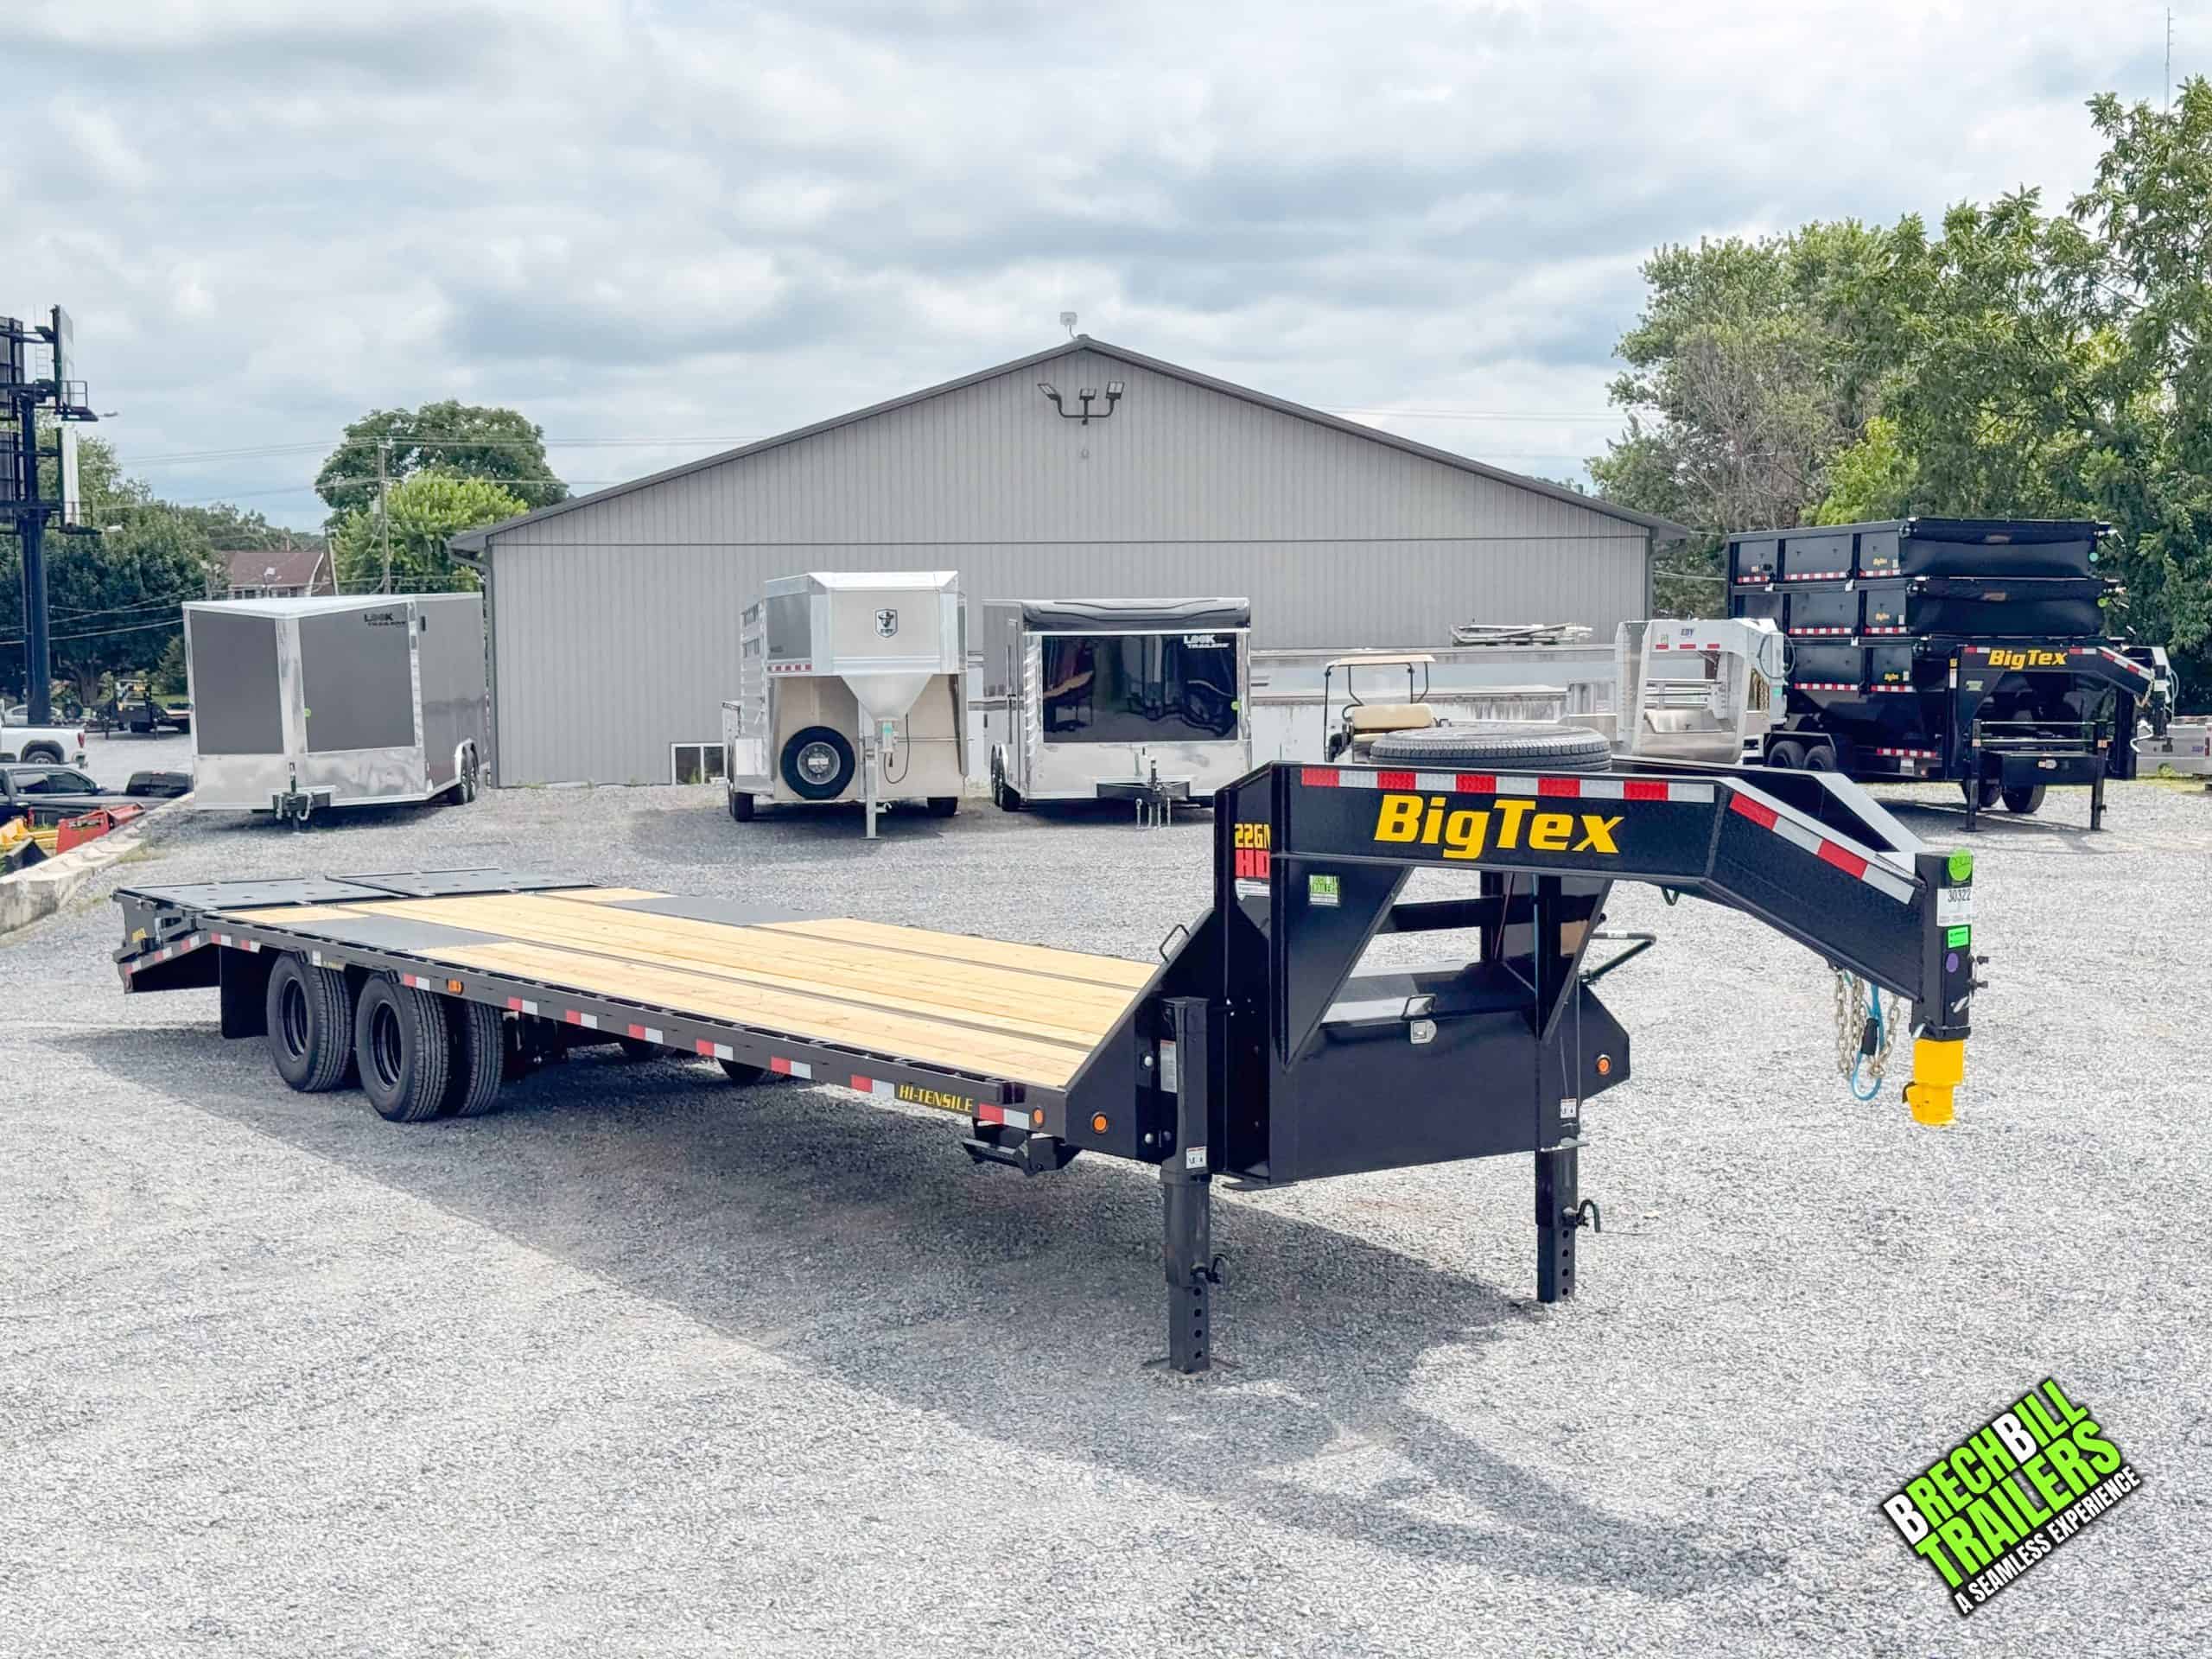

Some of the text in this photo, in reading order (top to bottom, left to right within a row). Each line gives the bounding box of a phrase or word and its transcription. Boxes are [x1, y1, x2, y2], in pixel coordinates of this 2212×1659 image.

[1988, 649, 2067, 671] BigTex
[1374, 794, 1624, 860] BigTex
[1235, 849, 1270, 878] HD
[1948, 889, 1972, 902] 30322
[899, 1084, 974, 1112] HI-TENSILE
